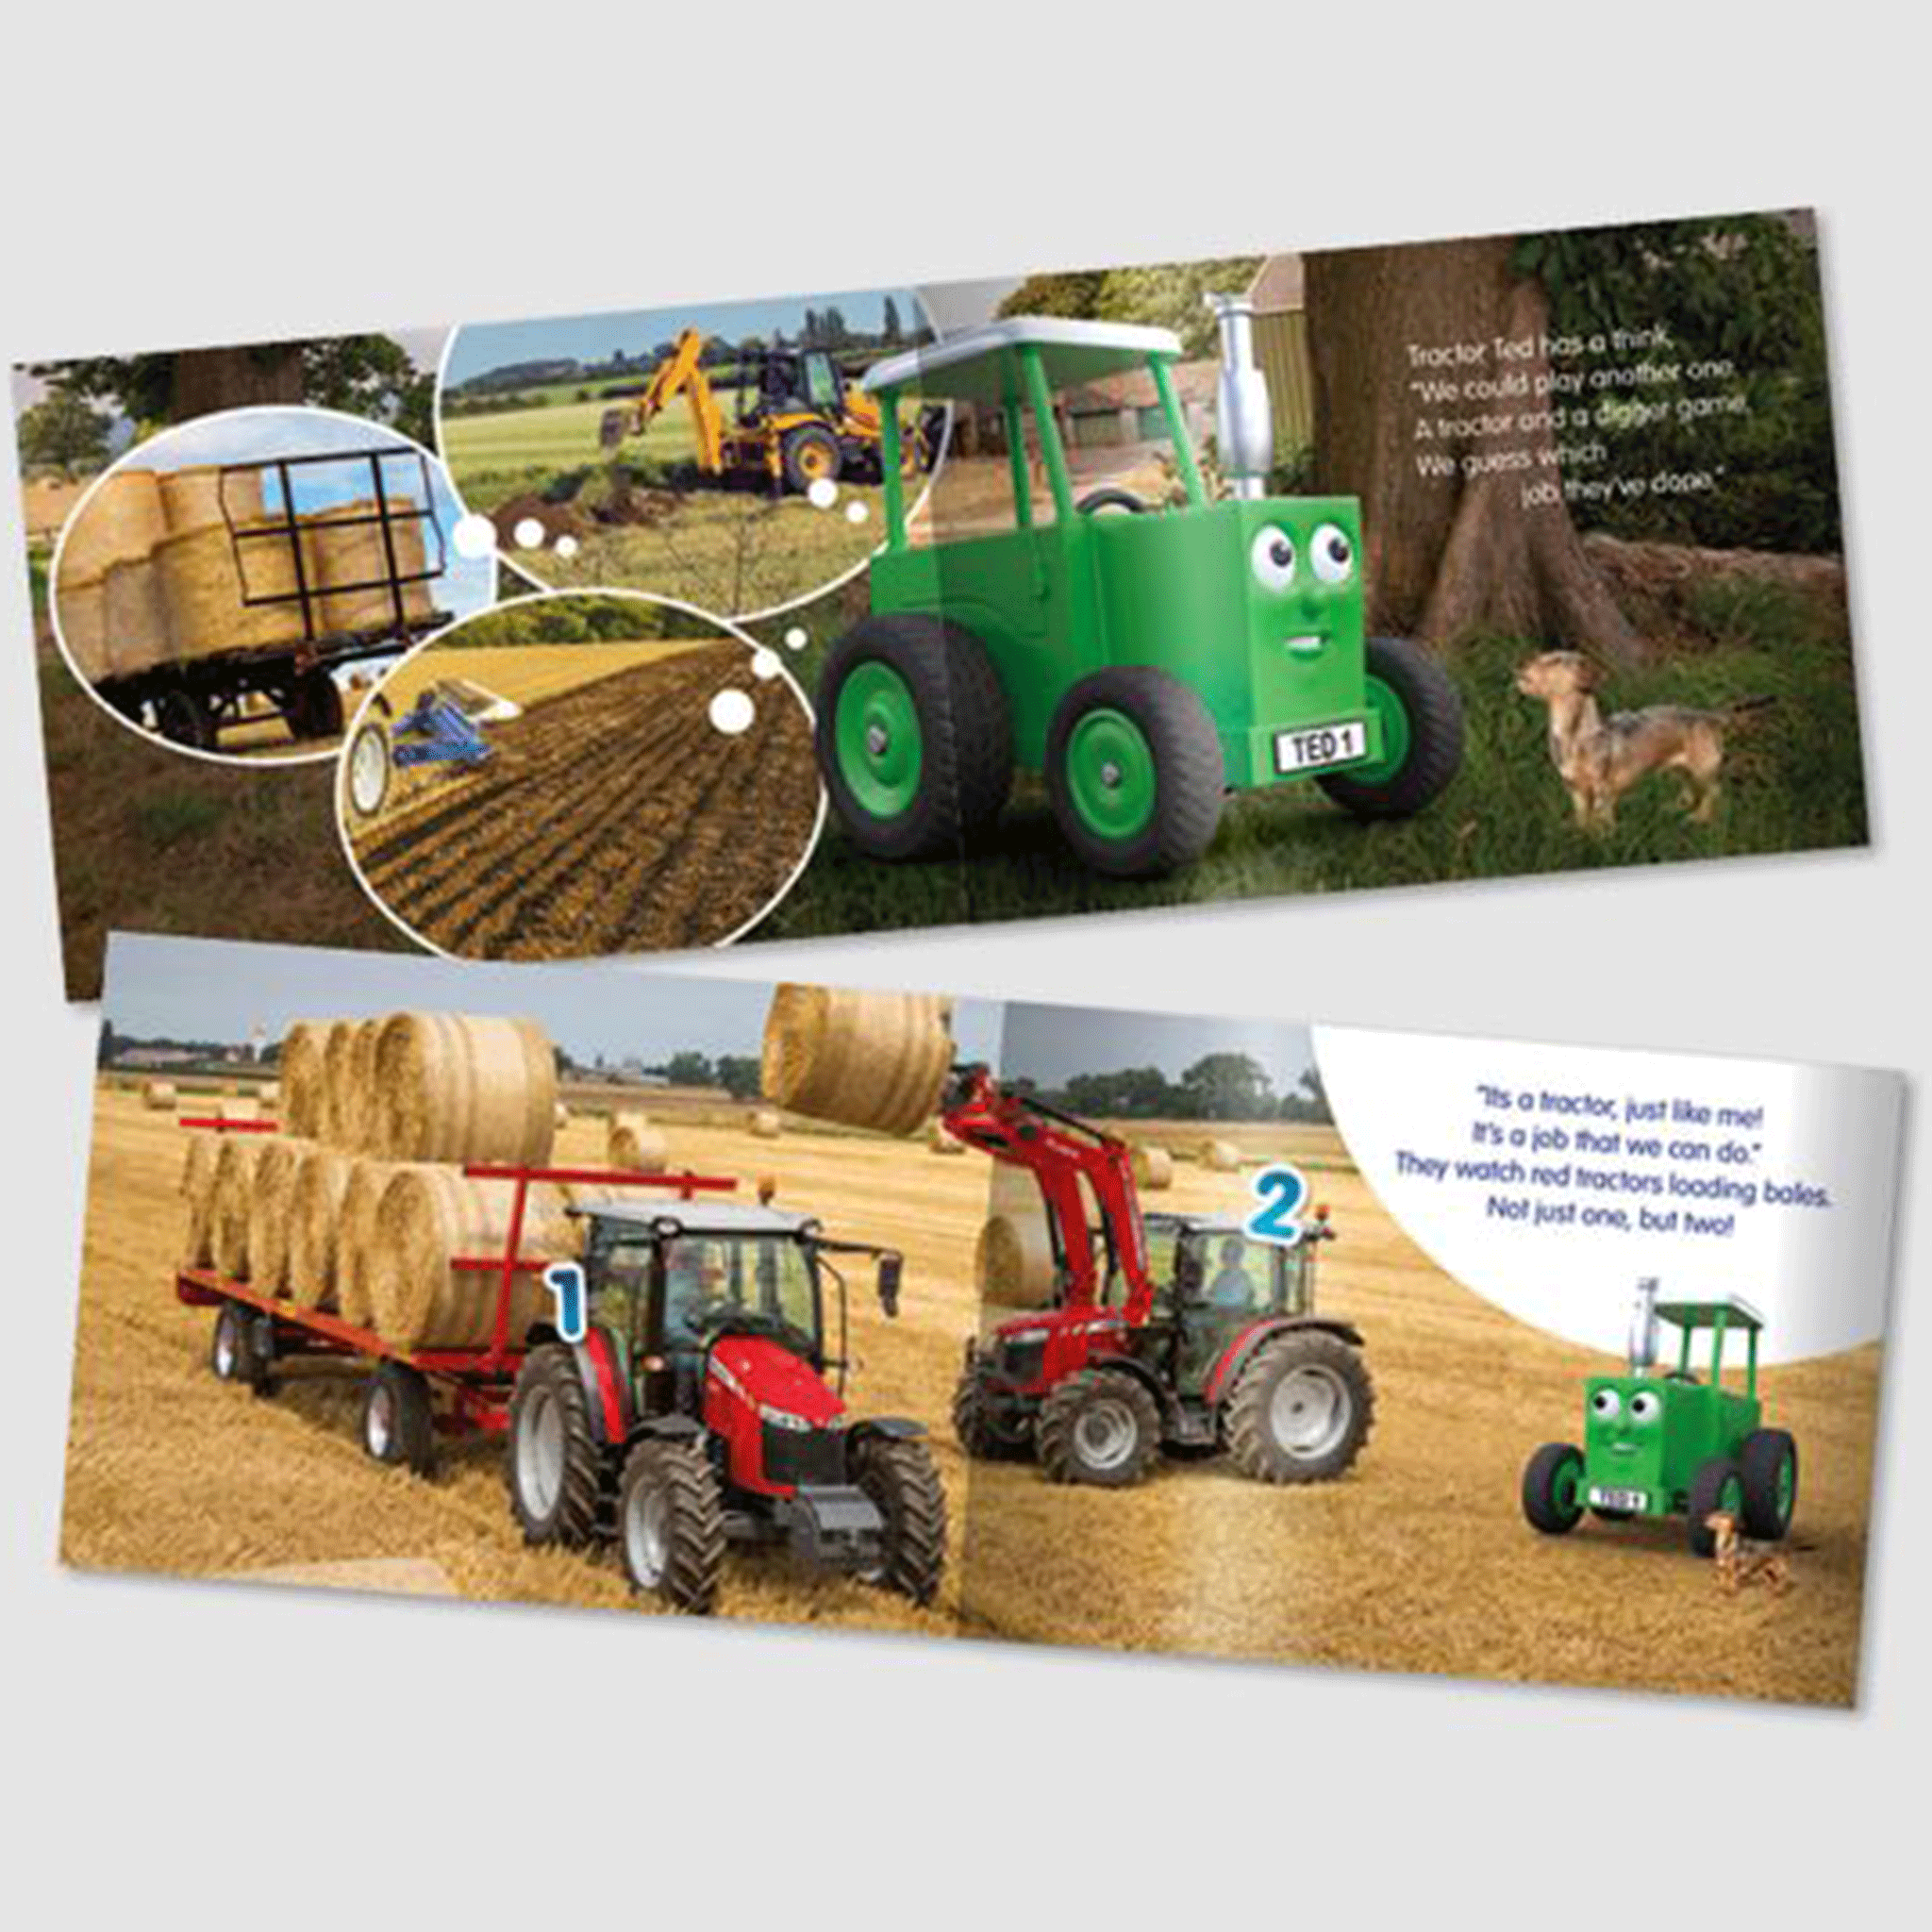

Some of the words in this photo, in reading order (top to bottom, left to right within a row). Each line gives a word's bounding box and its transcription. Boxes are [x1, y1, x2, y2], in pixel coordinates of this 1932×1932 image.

[1407, 341, 1487, 367] Tractor
[1492, 337, 1534, 359] Ted
[1539, 332, 1585, 357] has
[1588, 334, 1606, 354] a
[1463, 373, 1530, 400] could
[1534, 370, 1585, 397] play
[1589, 362, 1682, 389] another
[1414, 418, 1433, 441] A
[1437, 413, 1513, 438] tractor
[1517, 407, 1567, 432] and
[1571, 408, 1589, 427] a
[1593, 397, 1670, 429] digger
[1416, 454, 1456, 477] We
[1461, 450, 1533, 480] guess
[1537, 441, 1607, 467] which
[1520, 482, 1559, 509] job
[1292, 732, 1337, 763] TED
[1341, 729, 1353, 755] 1
[1517, 1091, 1535, 1111] a
[1625, 1097, 1667, 1124] just
[1672, 1097, 1711, 1125] like
[1716, 1105, 1763, 1129] me!
[1509, 1127, 1526, 1147] a
[1531, 1124, 1570, 1153] job
[1574, 1128, 1621, 1155] that
[1625, 1138, 1662, 1158] we
[1668, 1141, 1710, 1161] can
[1396, 1149, 1450, 1182] They
[1454, 1159, 1525, 1183] watch
[1531, 1163, 1571, 1188] red
[1575, 1167, 1663, 1195] tractors
[1668, 1172, 1757, 1207] loading
[1245, 1166, 1305, 1243] 2
[1486, 1195, 1530, 1221] Not
[1533, 1199, 1576, 1226] just
[1639, 1207, 1679, 1231] but
[1683, 1212, 1736, 1237] two!
[546, 1265, 584, 1340] 1
